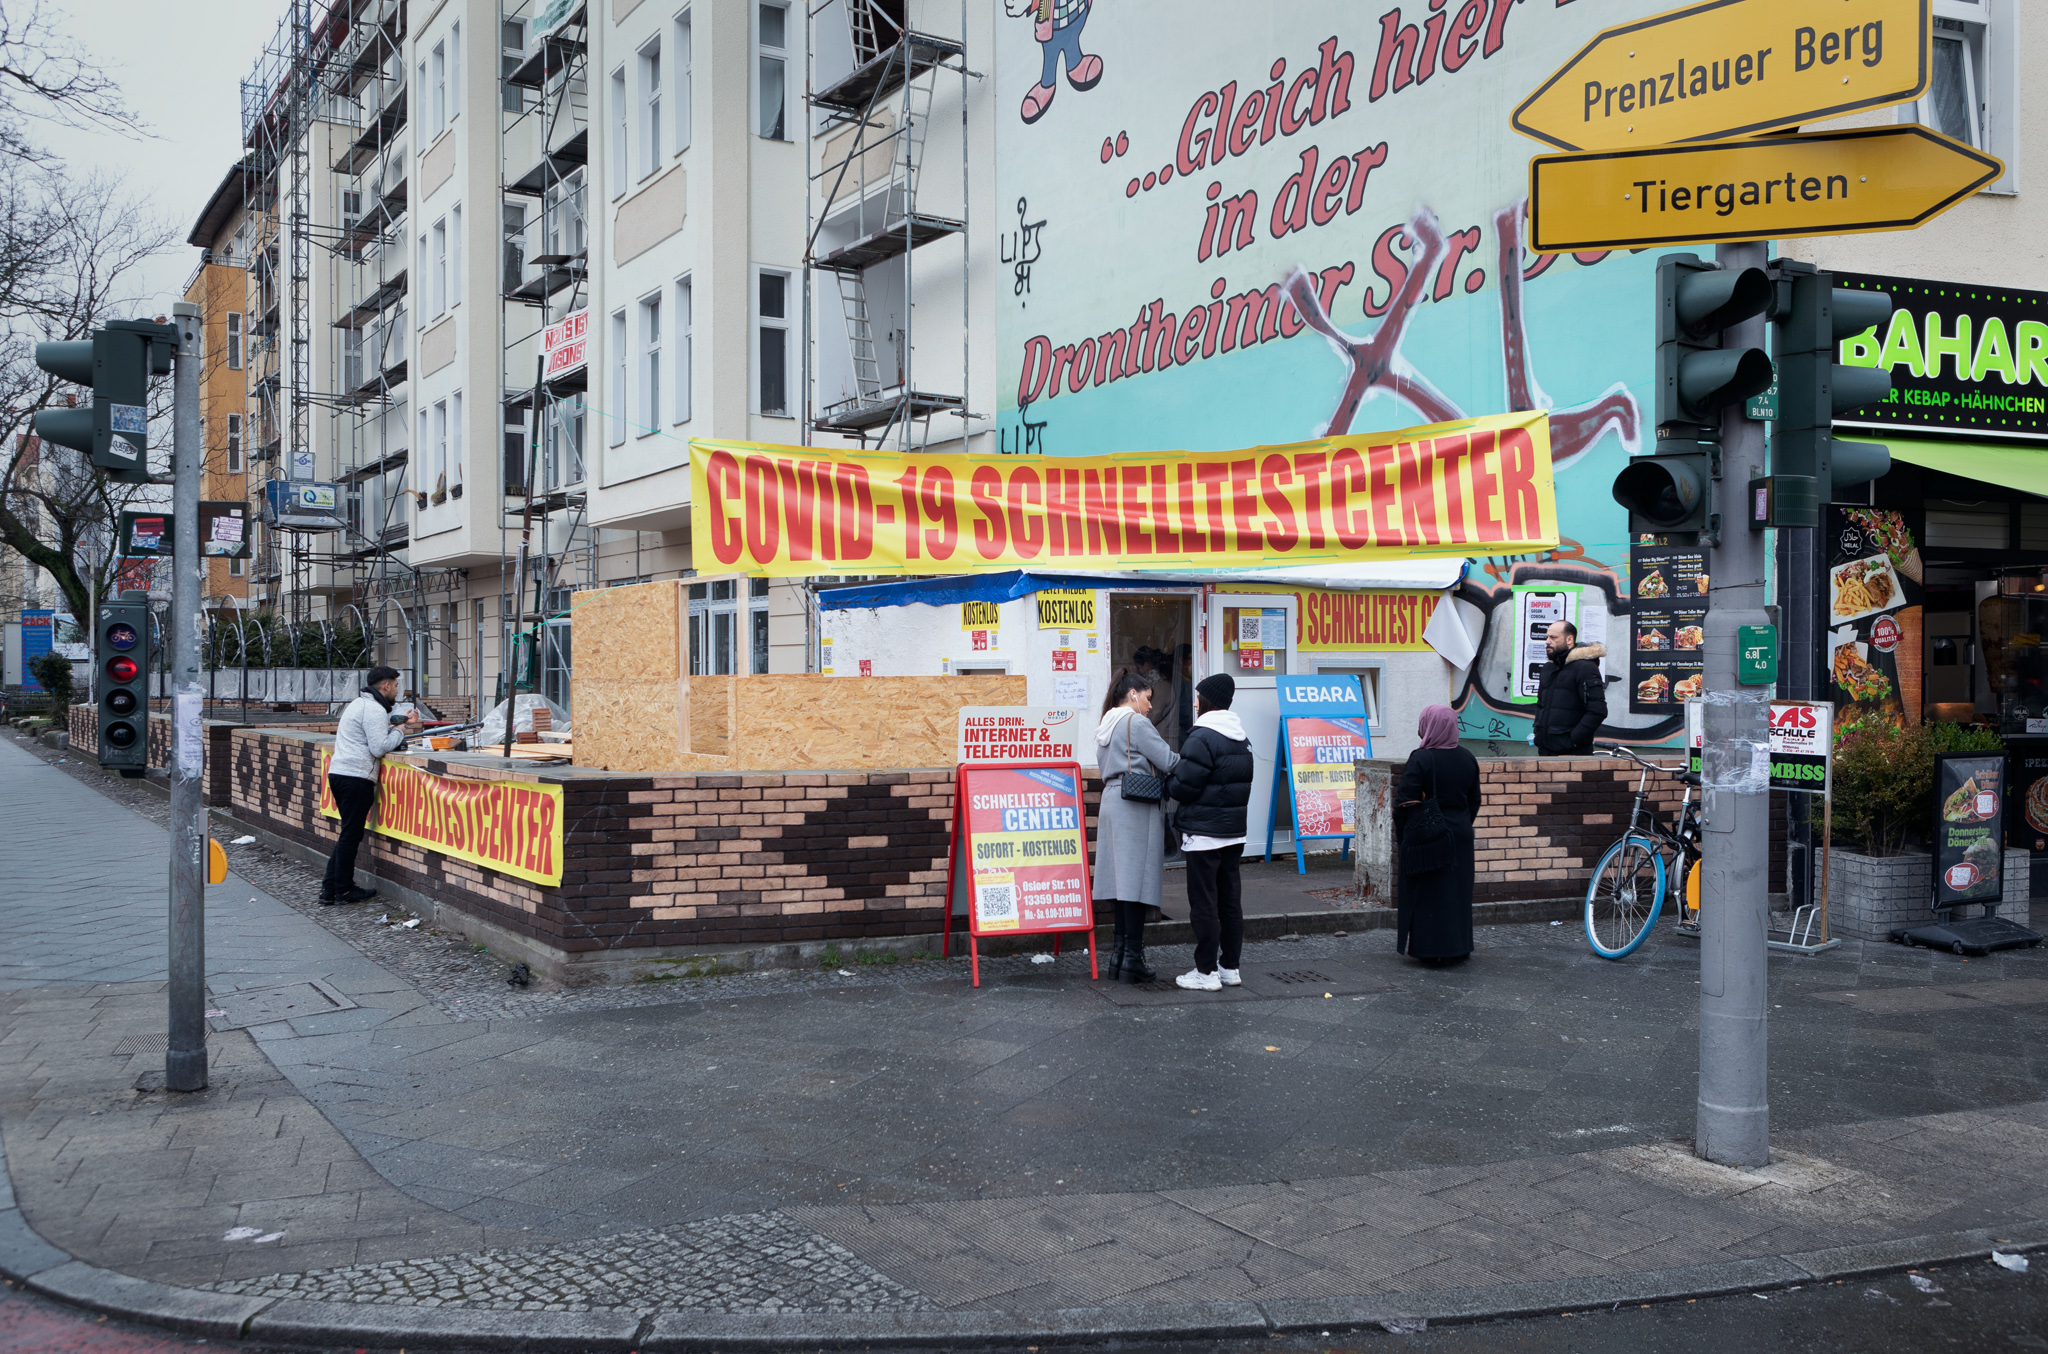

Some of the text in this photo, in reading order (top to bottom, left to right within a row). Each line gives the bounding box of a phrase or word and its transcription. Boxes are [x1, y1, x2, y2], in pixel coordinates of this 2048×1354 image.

[1368, 0, 1527, 103] hier
[1583, 19, 1883, 122] Prenzlauer Berg
[1633, 172, 1848, 217] Tiergarten
[1198, 142, 1389, 264] in der
[1758, 396, 1769, 405] 7.4
[1904, 389, 1951, 407] KEBAP
[1961, 389, 2045, 414] HÄHNCHEN
[1752, 407, 1774, 417] BLN10
[1657, 428, 1670, 438] F17
[706, 450, 958, 565] COVID-19
[1038, 600, 1094, 624] KOSTENLOS
[1530, 601, 1552, 609] IMPFEN
[963, 602, 998, 625] KOSTENLOS
[1307, 592, 1418, 645] SCHNELLTEST
[22, 617, 51, 627] ZACK
[1876, 625, 1894, 637] 100%
[1874, 634, 1898, 644] QUALITÄT
[1755, 660, 1767, 670] 4.0
[1284, 686, 1358, 703] LEBARA
[965, 716, 1025, 727] ALLES DRIN:
[964, 728, 1051, 743] INTERNET &
[1292, 735, 1352, 748] SCHNELLTEST
[964, 743, 1073, 759] TELEFONIEREN
[1316, 746, 1366, 764] CENTER
[1297, 770, 1325, 784] SOFORT
[973, 792, 1056, 810] SCHNELLTEST
[1004, 807, 1075, 831] CENTER
[976, 841, 1015, 860] SOFORT
[1022, 838, 1077, 857] KOSTENLOS
[1022, 878, 1080, 892] Osloer Str. 110
[1023, 893, 1082, 906] 13359 Berlin
[1072, 907, 1083, 917] Uhr
